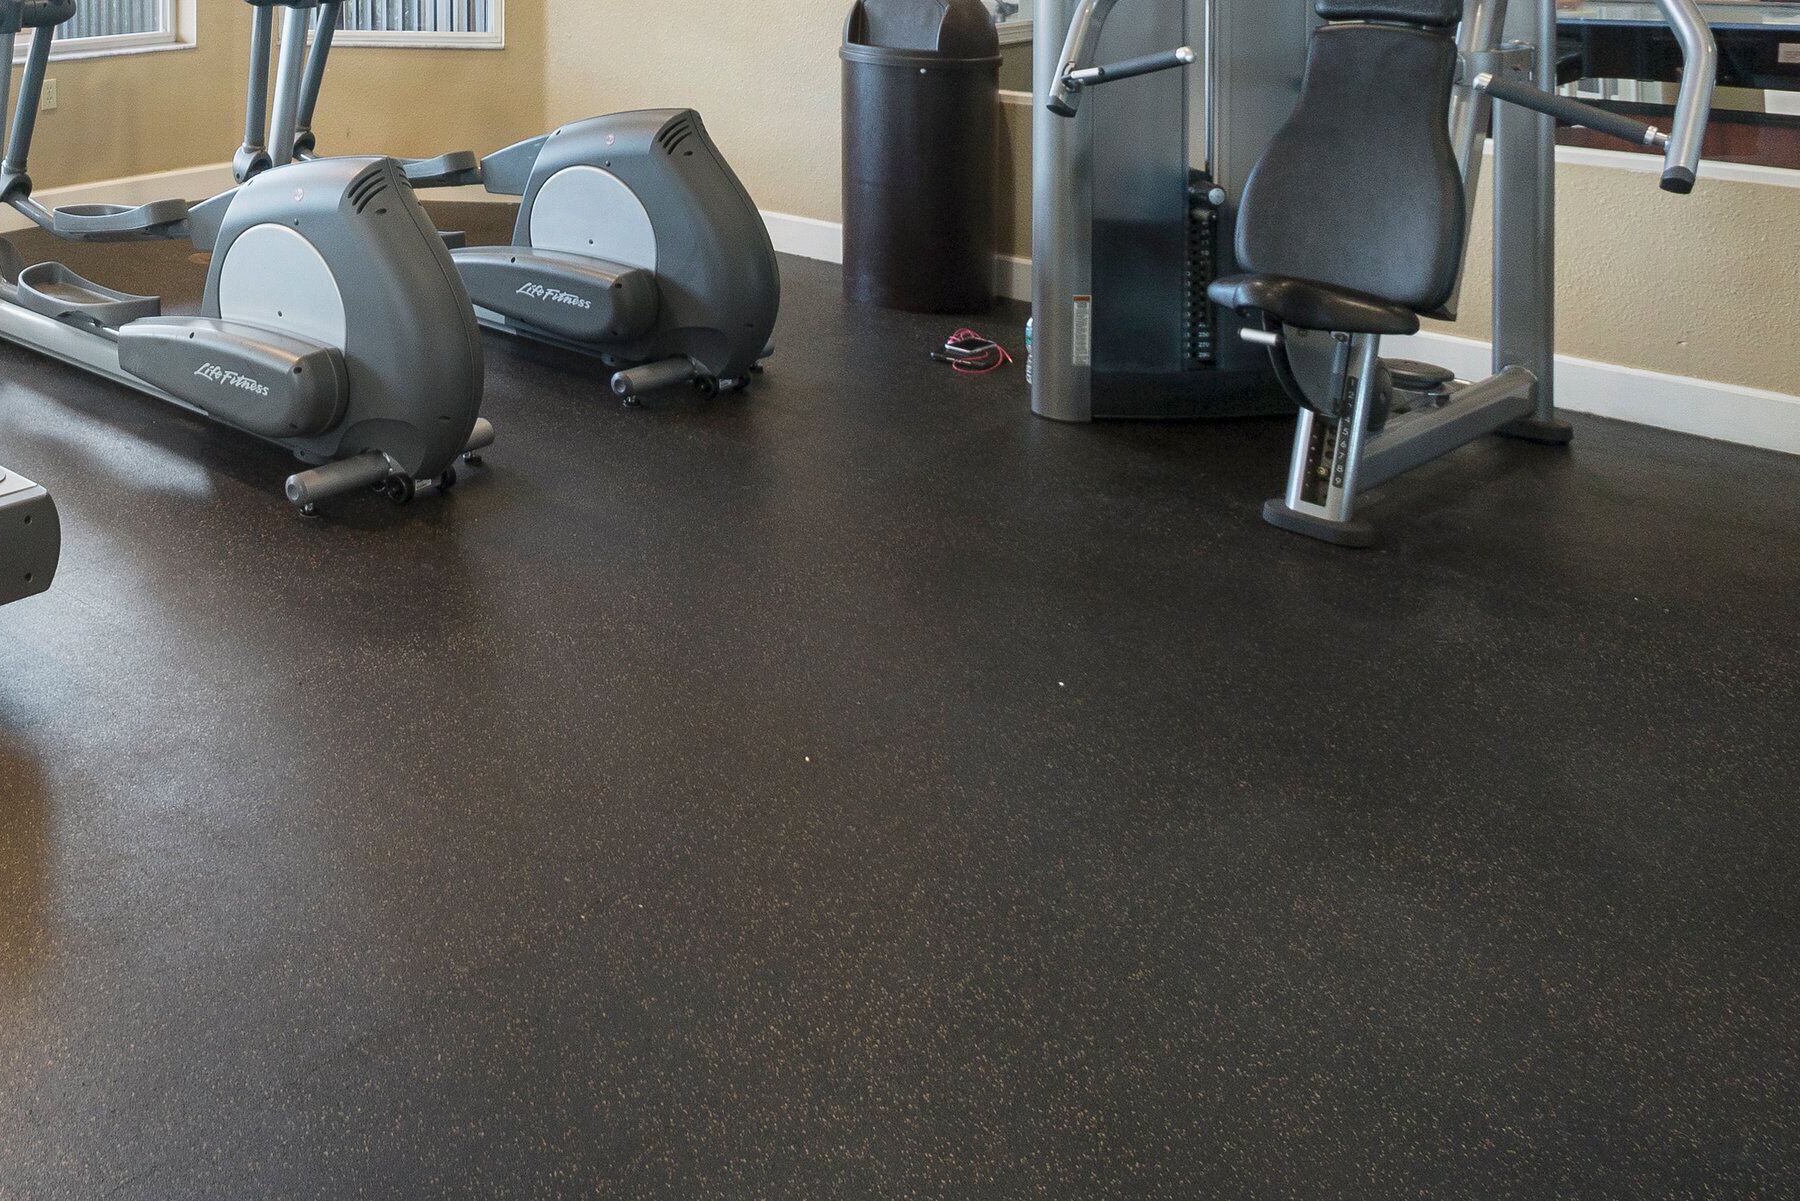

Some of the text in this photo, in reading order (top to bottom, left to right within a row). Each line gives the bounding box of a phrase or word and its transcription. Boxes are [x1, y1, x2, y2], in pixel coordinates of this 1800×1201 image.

[516, 282, 591, 309] Life Fitness
[194, 363, 269, 396] Life Fitness
